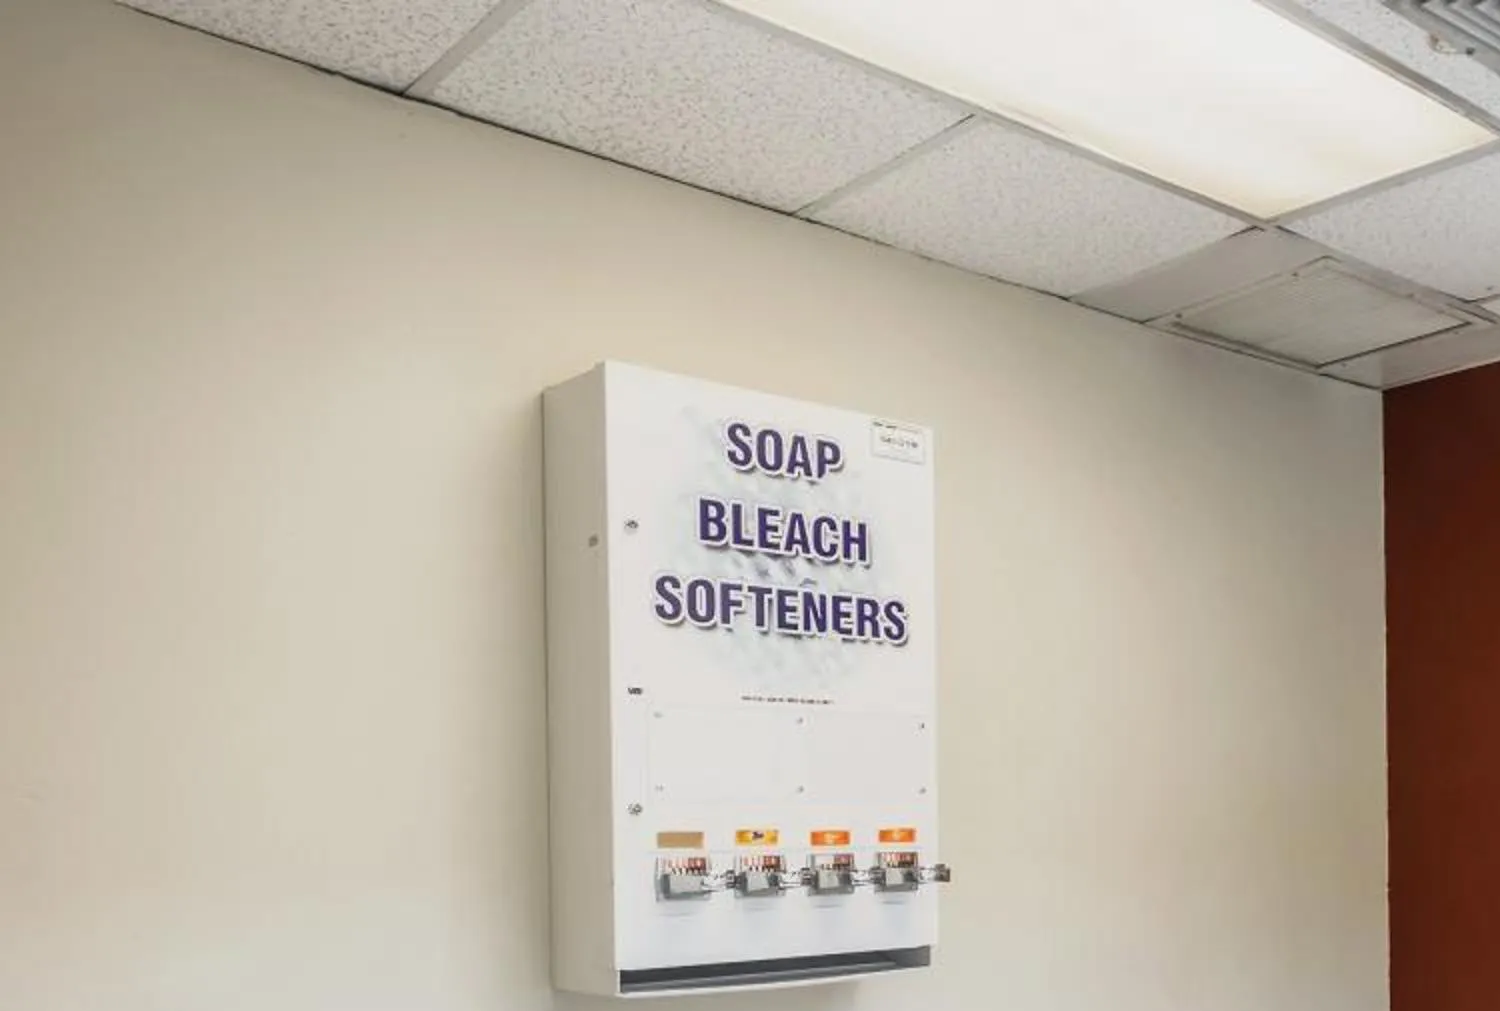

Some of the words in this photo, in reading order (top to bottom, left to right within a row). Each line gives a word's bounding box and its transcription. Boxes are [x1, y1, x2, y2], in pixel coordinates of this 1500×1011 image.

[726, 423, 842, 478] SOAP
[699, 498, 867, 562] BLEACH
[654, 575, 906, 641] SOFTENERS
